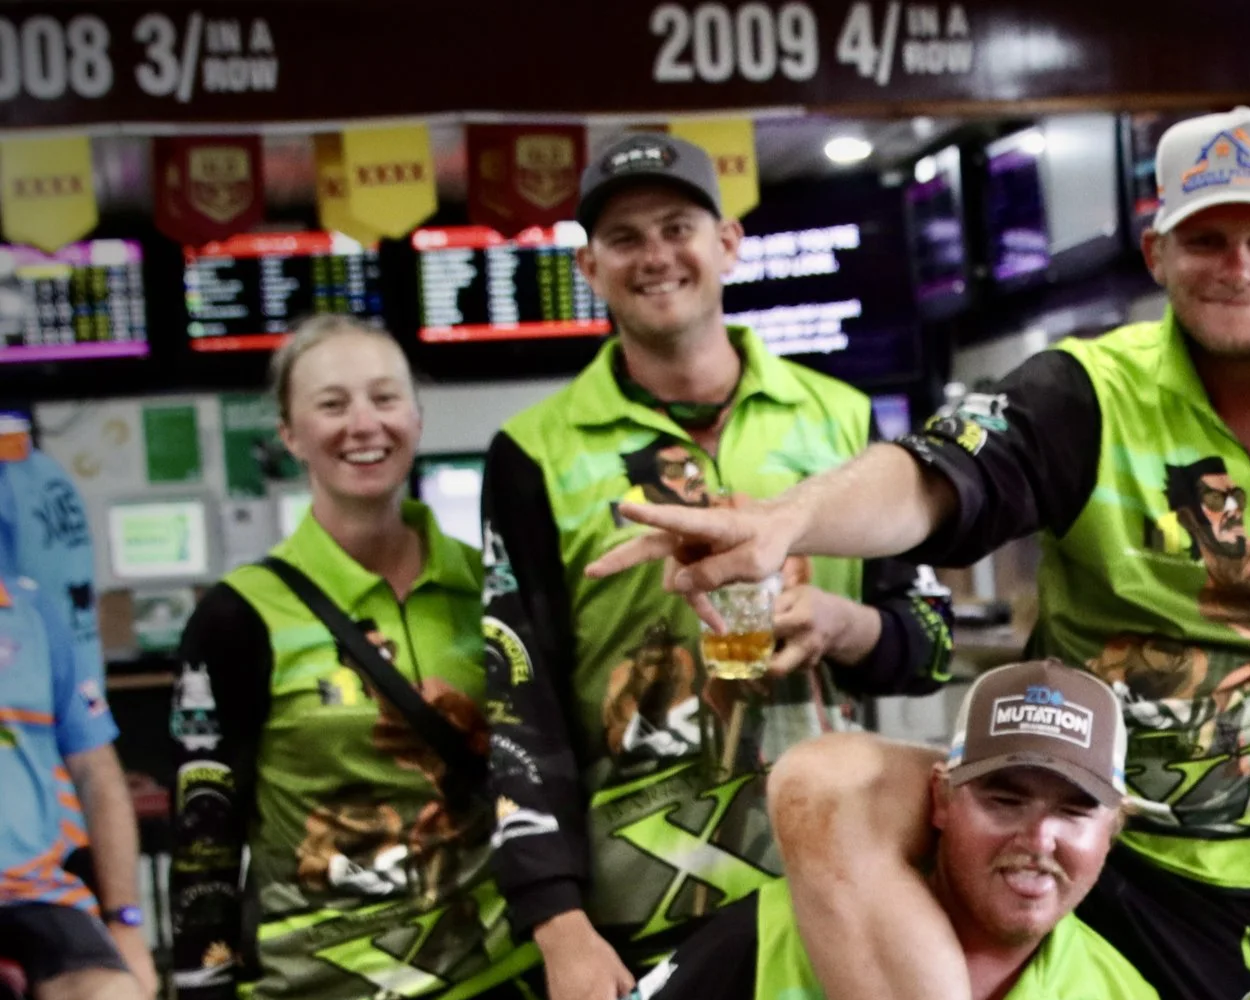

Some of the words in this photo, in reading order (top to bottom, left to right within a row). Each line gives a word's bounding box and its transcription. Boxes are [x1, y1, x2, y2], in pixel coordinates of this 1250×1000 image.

[250, 18, 274, 50] A
[947, 4, 968, 36] A
[133, 10, 202, 103] 3/
[652, 3, 819, 82] 2009
[835, 0, 901, 87] 4/
[904, 39, 973, 74] ROW
[203, 56, 279, 92] ROW
[996, 705, 1089, 735] MUTATION
